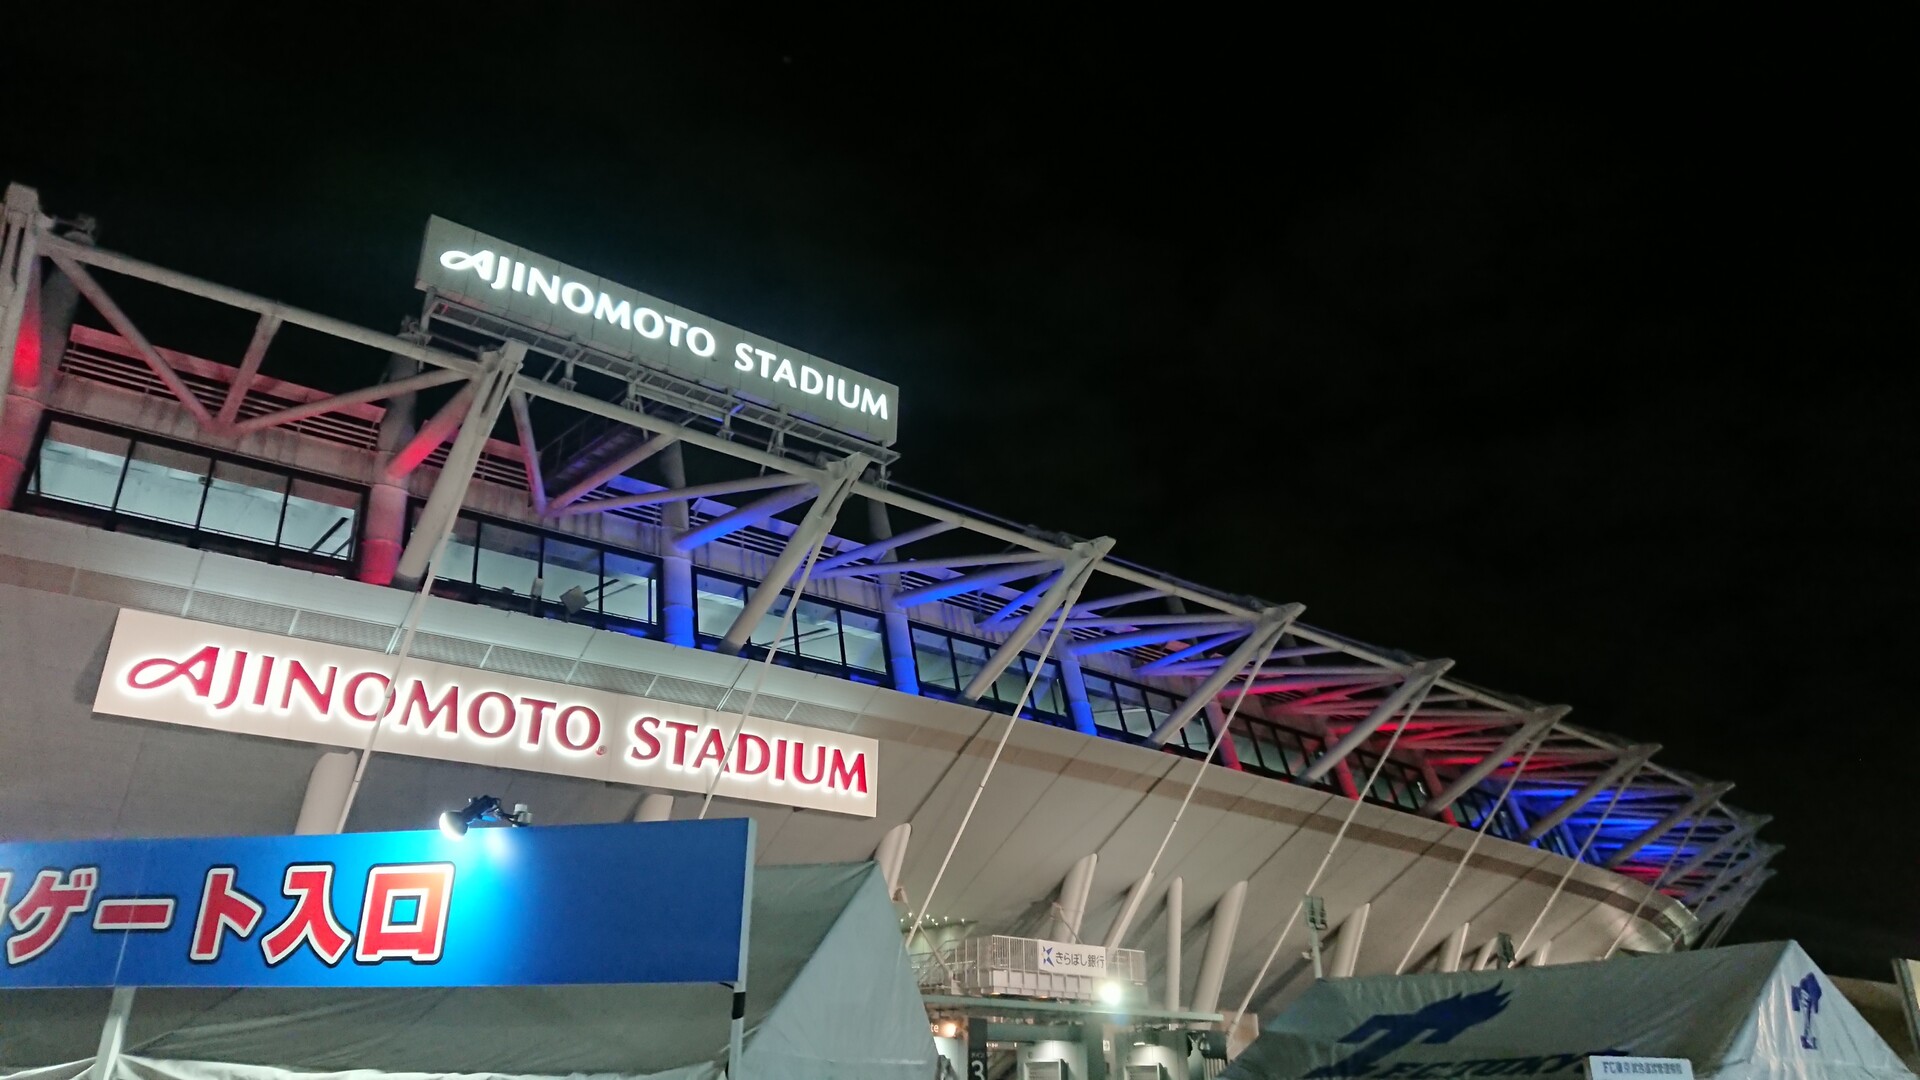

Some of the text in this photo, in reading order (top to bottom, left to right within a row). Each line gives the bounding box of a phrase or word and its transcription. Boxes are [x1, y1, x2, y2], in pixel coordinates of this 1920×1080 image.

[439, 249, 888, 420] AJINOMOTO STADIUM
[127, 646, 868, 795] AJINOMOTO STADIUM
[0, 861, 457, 967] ゲート入口
[1055, 951, 1105, 968] きらぼし銀行
